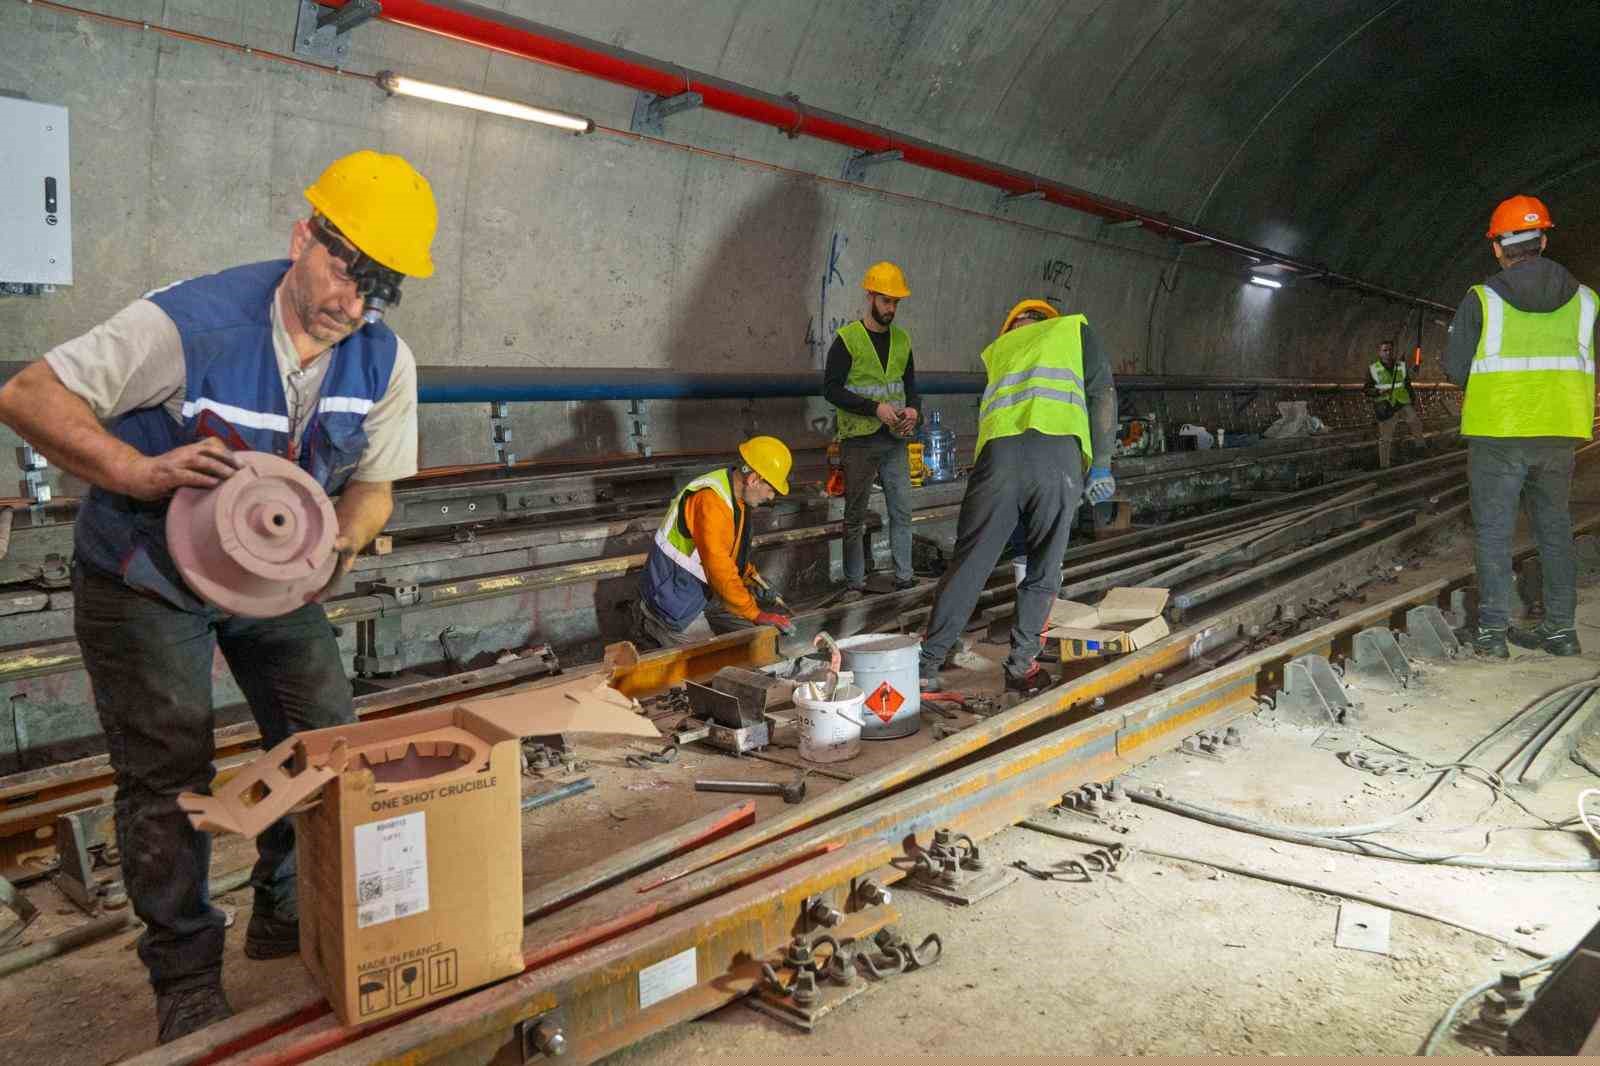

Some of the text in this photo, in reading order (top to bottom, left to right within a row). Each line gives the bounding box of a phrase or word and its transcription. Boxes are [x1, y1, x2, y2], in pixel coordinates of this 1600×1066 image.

[371, 776, 497, 812] ONE SHOT CRUCIBLE
[357, 943, 442, 971] MADE IN FRANCE
